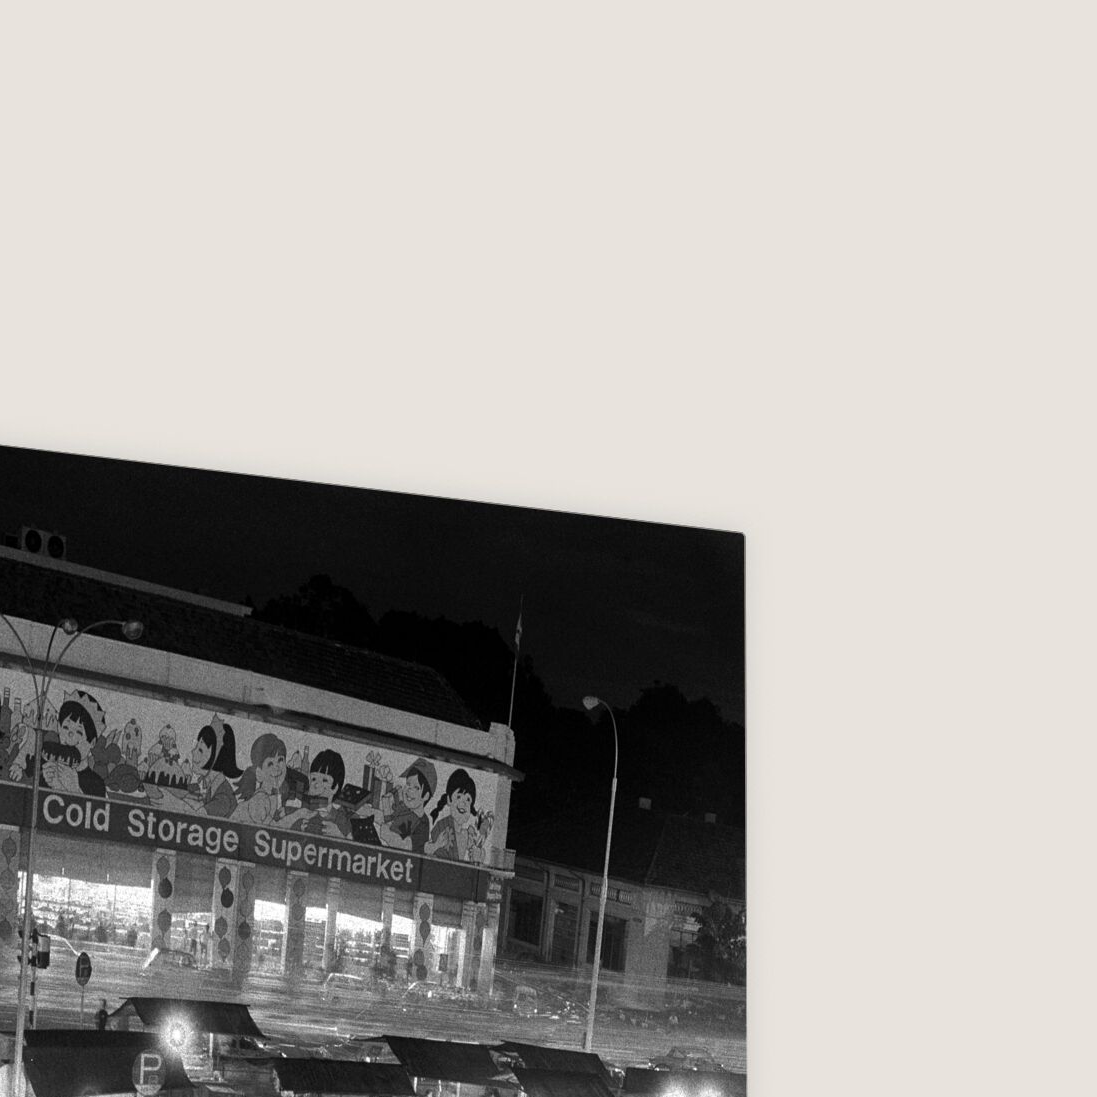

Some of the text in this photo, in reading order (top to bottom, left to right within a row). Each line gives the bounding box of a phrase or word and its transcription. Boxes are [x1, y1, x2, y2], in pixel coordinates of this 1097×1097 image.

[43, 795, 414, 883] Cold Storage Supermarket
[140, 1053, 162, 1085] P
